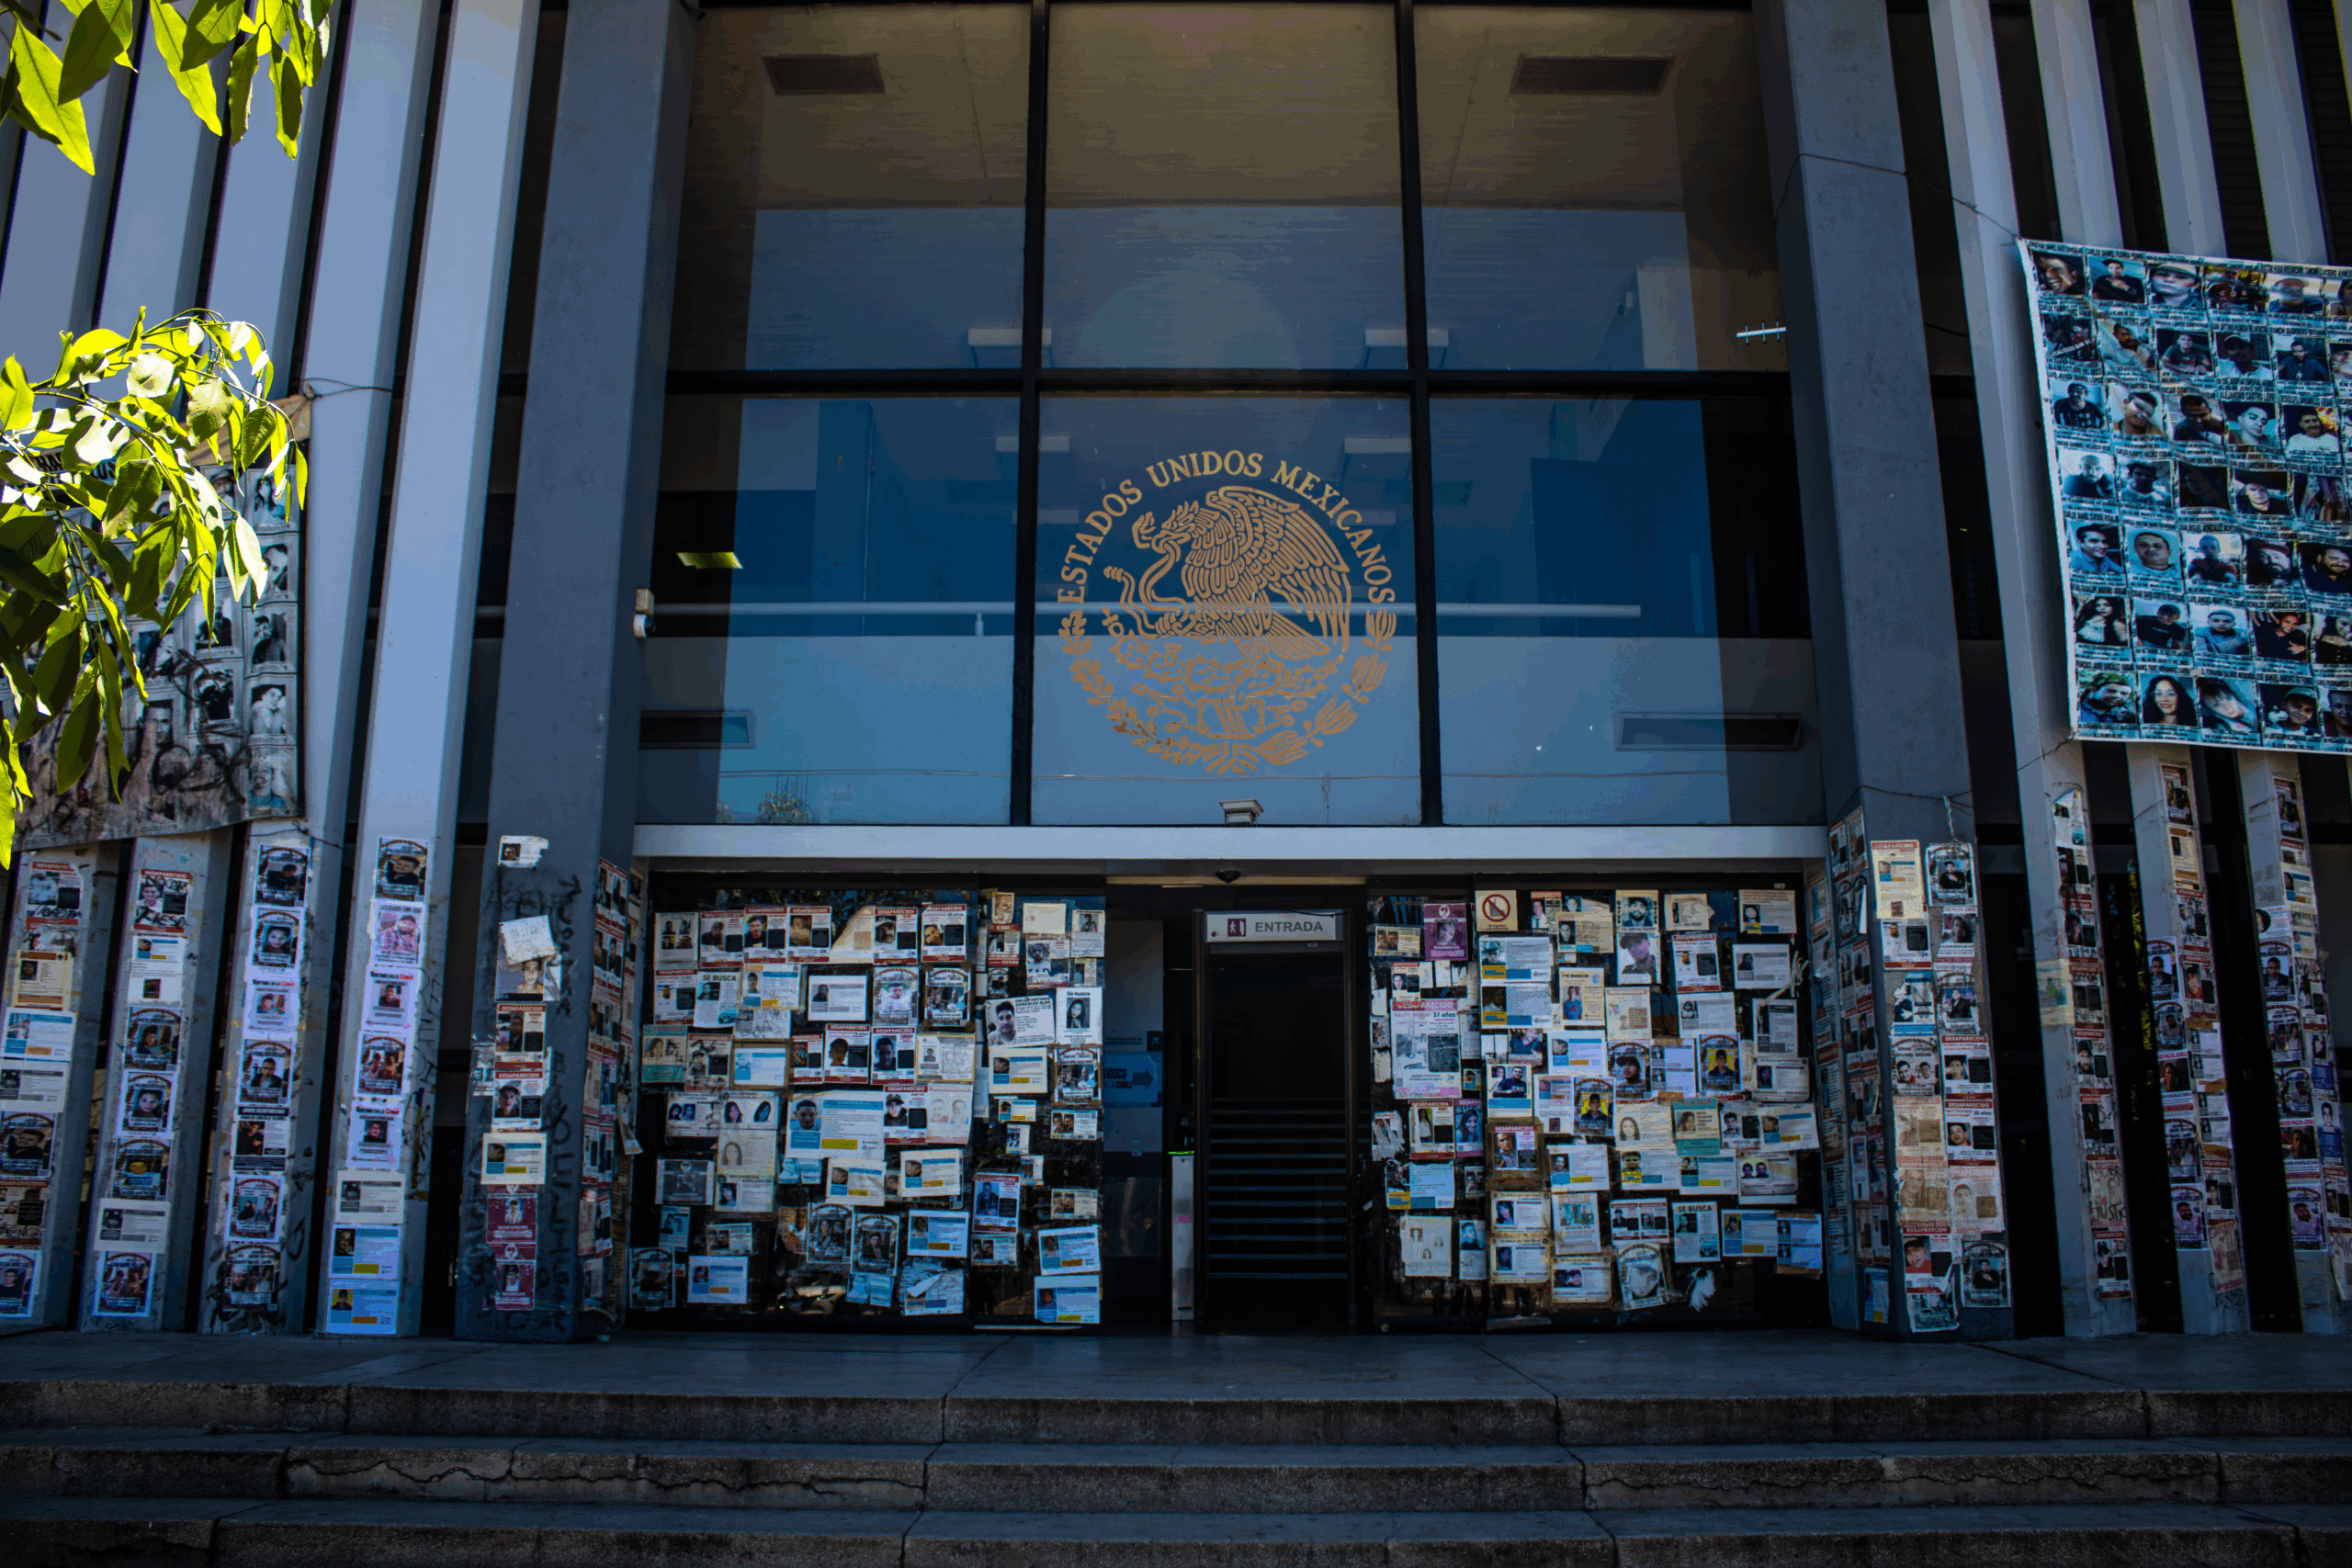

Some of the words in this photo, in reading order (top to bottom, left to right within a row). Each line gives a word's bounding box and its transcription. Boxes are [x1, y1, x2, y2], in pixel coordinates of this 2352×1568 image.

[1057, 479, 1143, 604] ESTADOS
[1145, 449, 1264, 488] UNIDOS
[1270, 460, 1396, 604] MEXICANOS
[1255, 921, 1324, 932] ENTRADA
